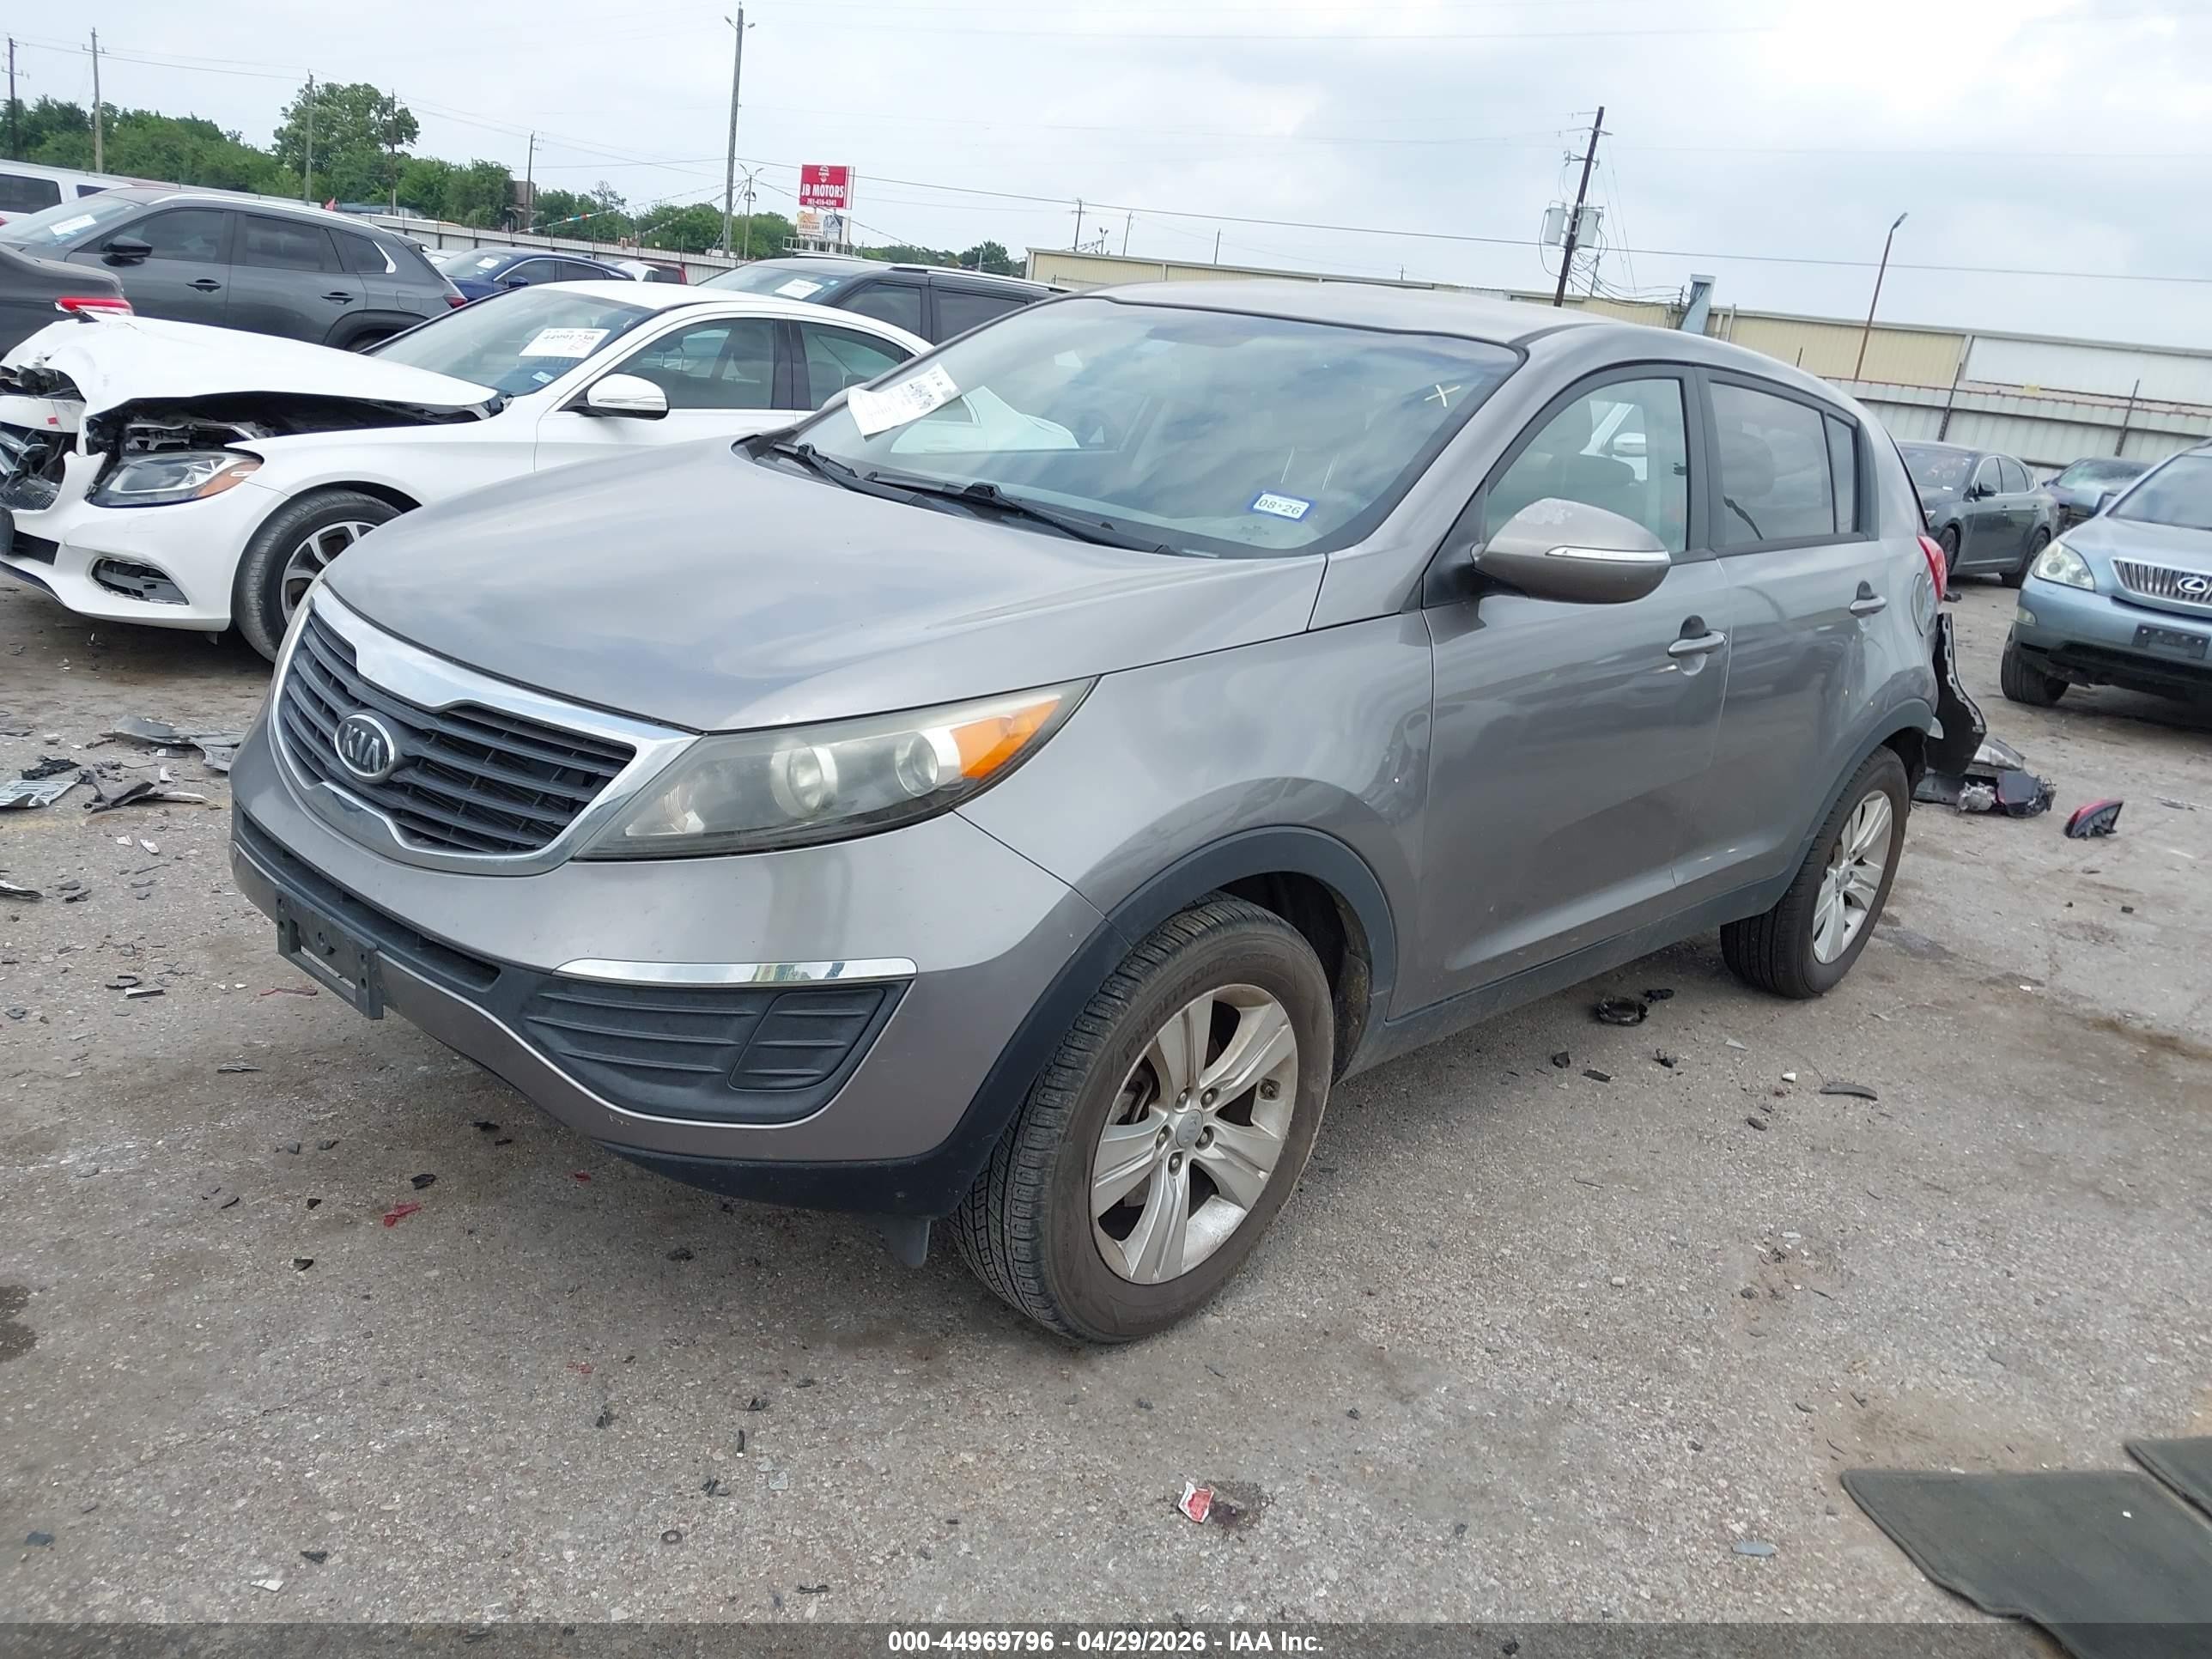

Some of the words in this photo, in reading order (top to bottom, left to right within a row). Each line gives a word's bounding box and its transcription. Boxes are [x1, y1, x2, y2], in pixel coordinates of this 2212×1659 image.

[802, 184, 811, 197] JB
[812, 184, 844, 198] MOTORS
[1259, 499, 1277, 509] 08
[1281, 505, 1301, 514] 26
[342, 723, 380, 771] KIA
